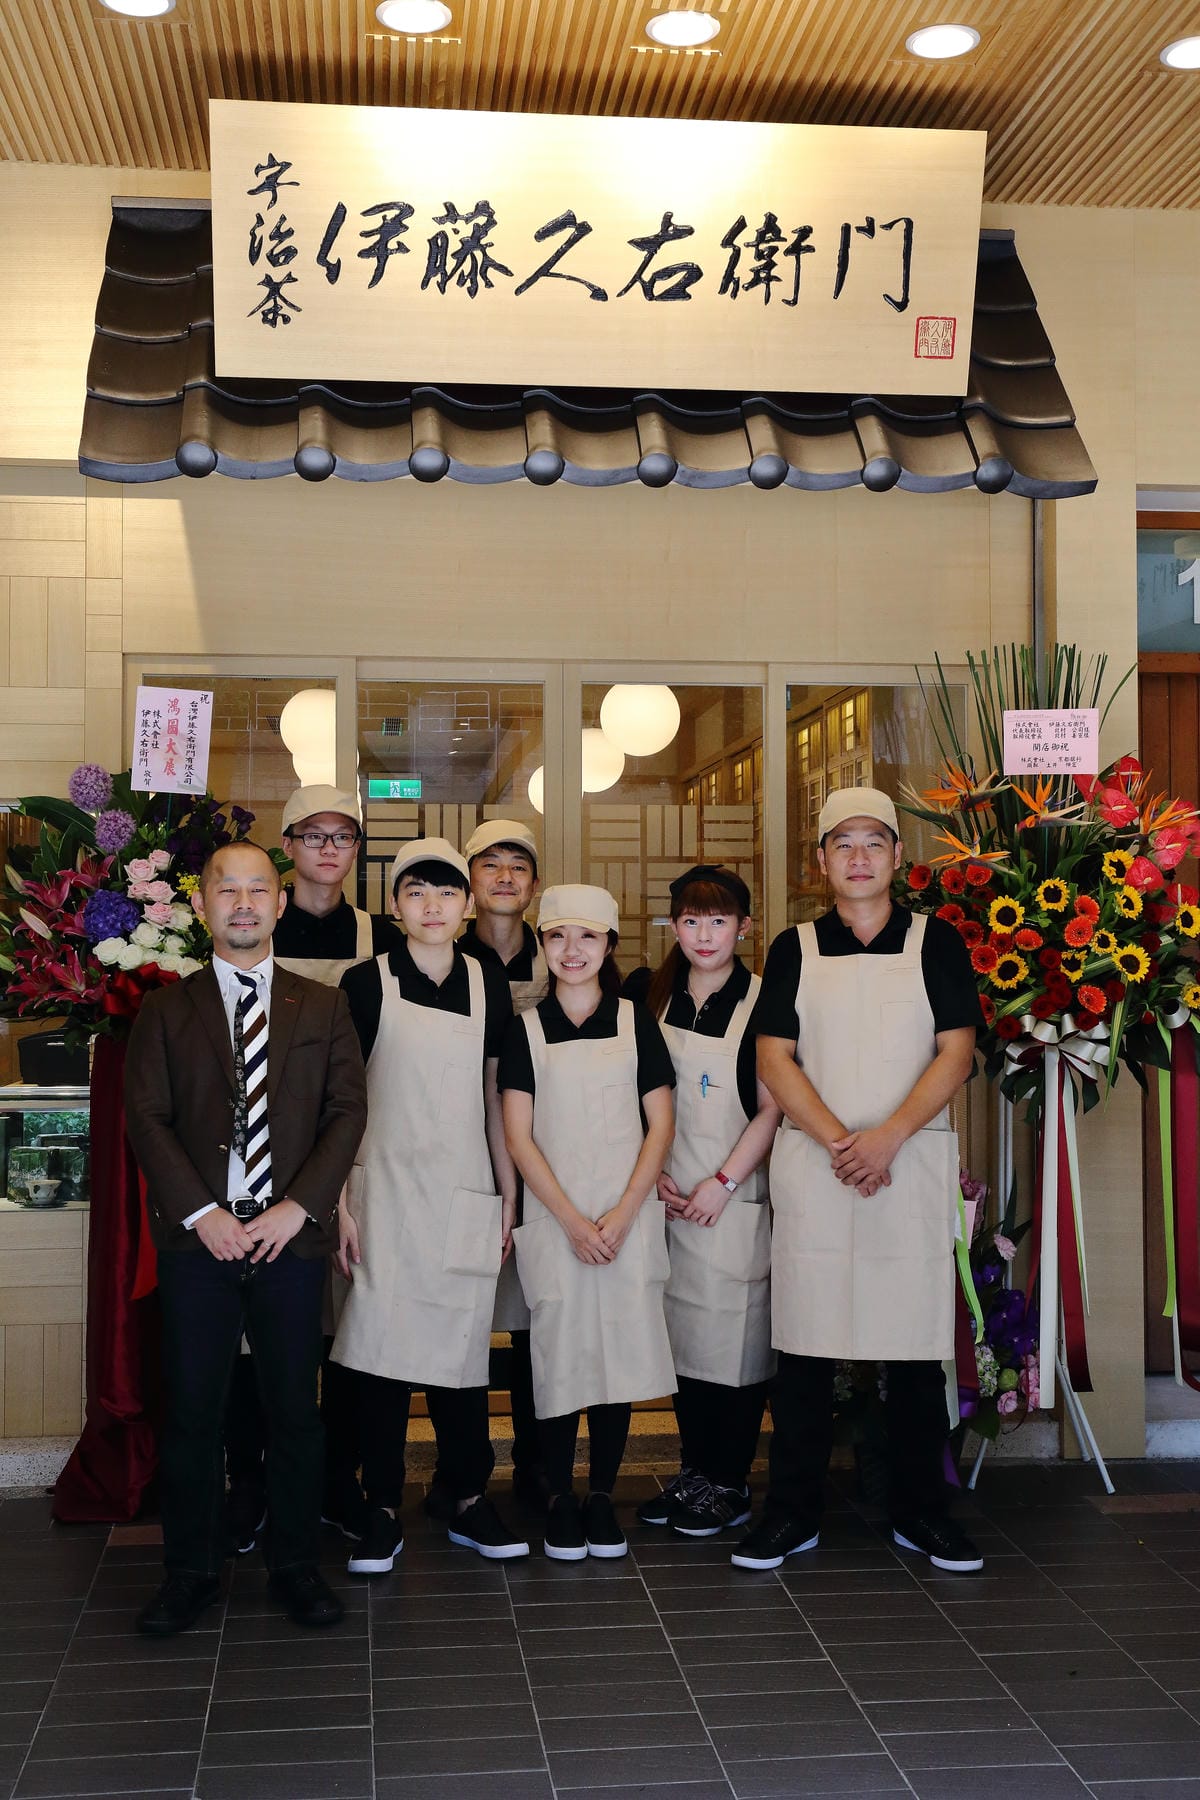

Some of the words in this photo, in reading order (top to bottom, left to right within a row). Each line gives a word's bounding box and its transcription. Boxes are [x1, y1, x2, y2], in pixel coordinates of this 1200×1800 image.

[247, 152, 302, 328] 宇治茶
[316, 200, 914, 313] 伊藤久右衛門
[163, 698, 181, 776] 鴻圖大展
[200, 693, 210, 705] 祝
